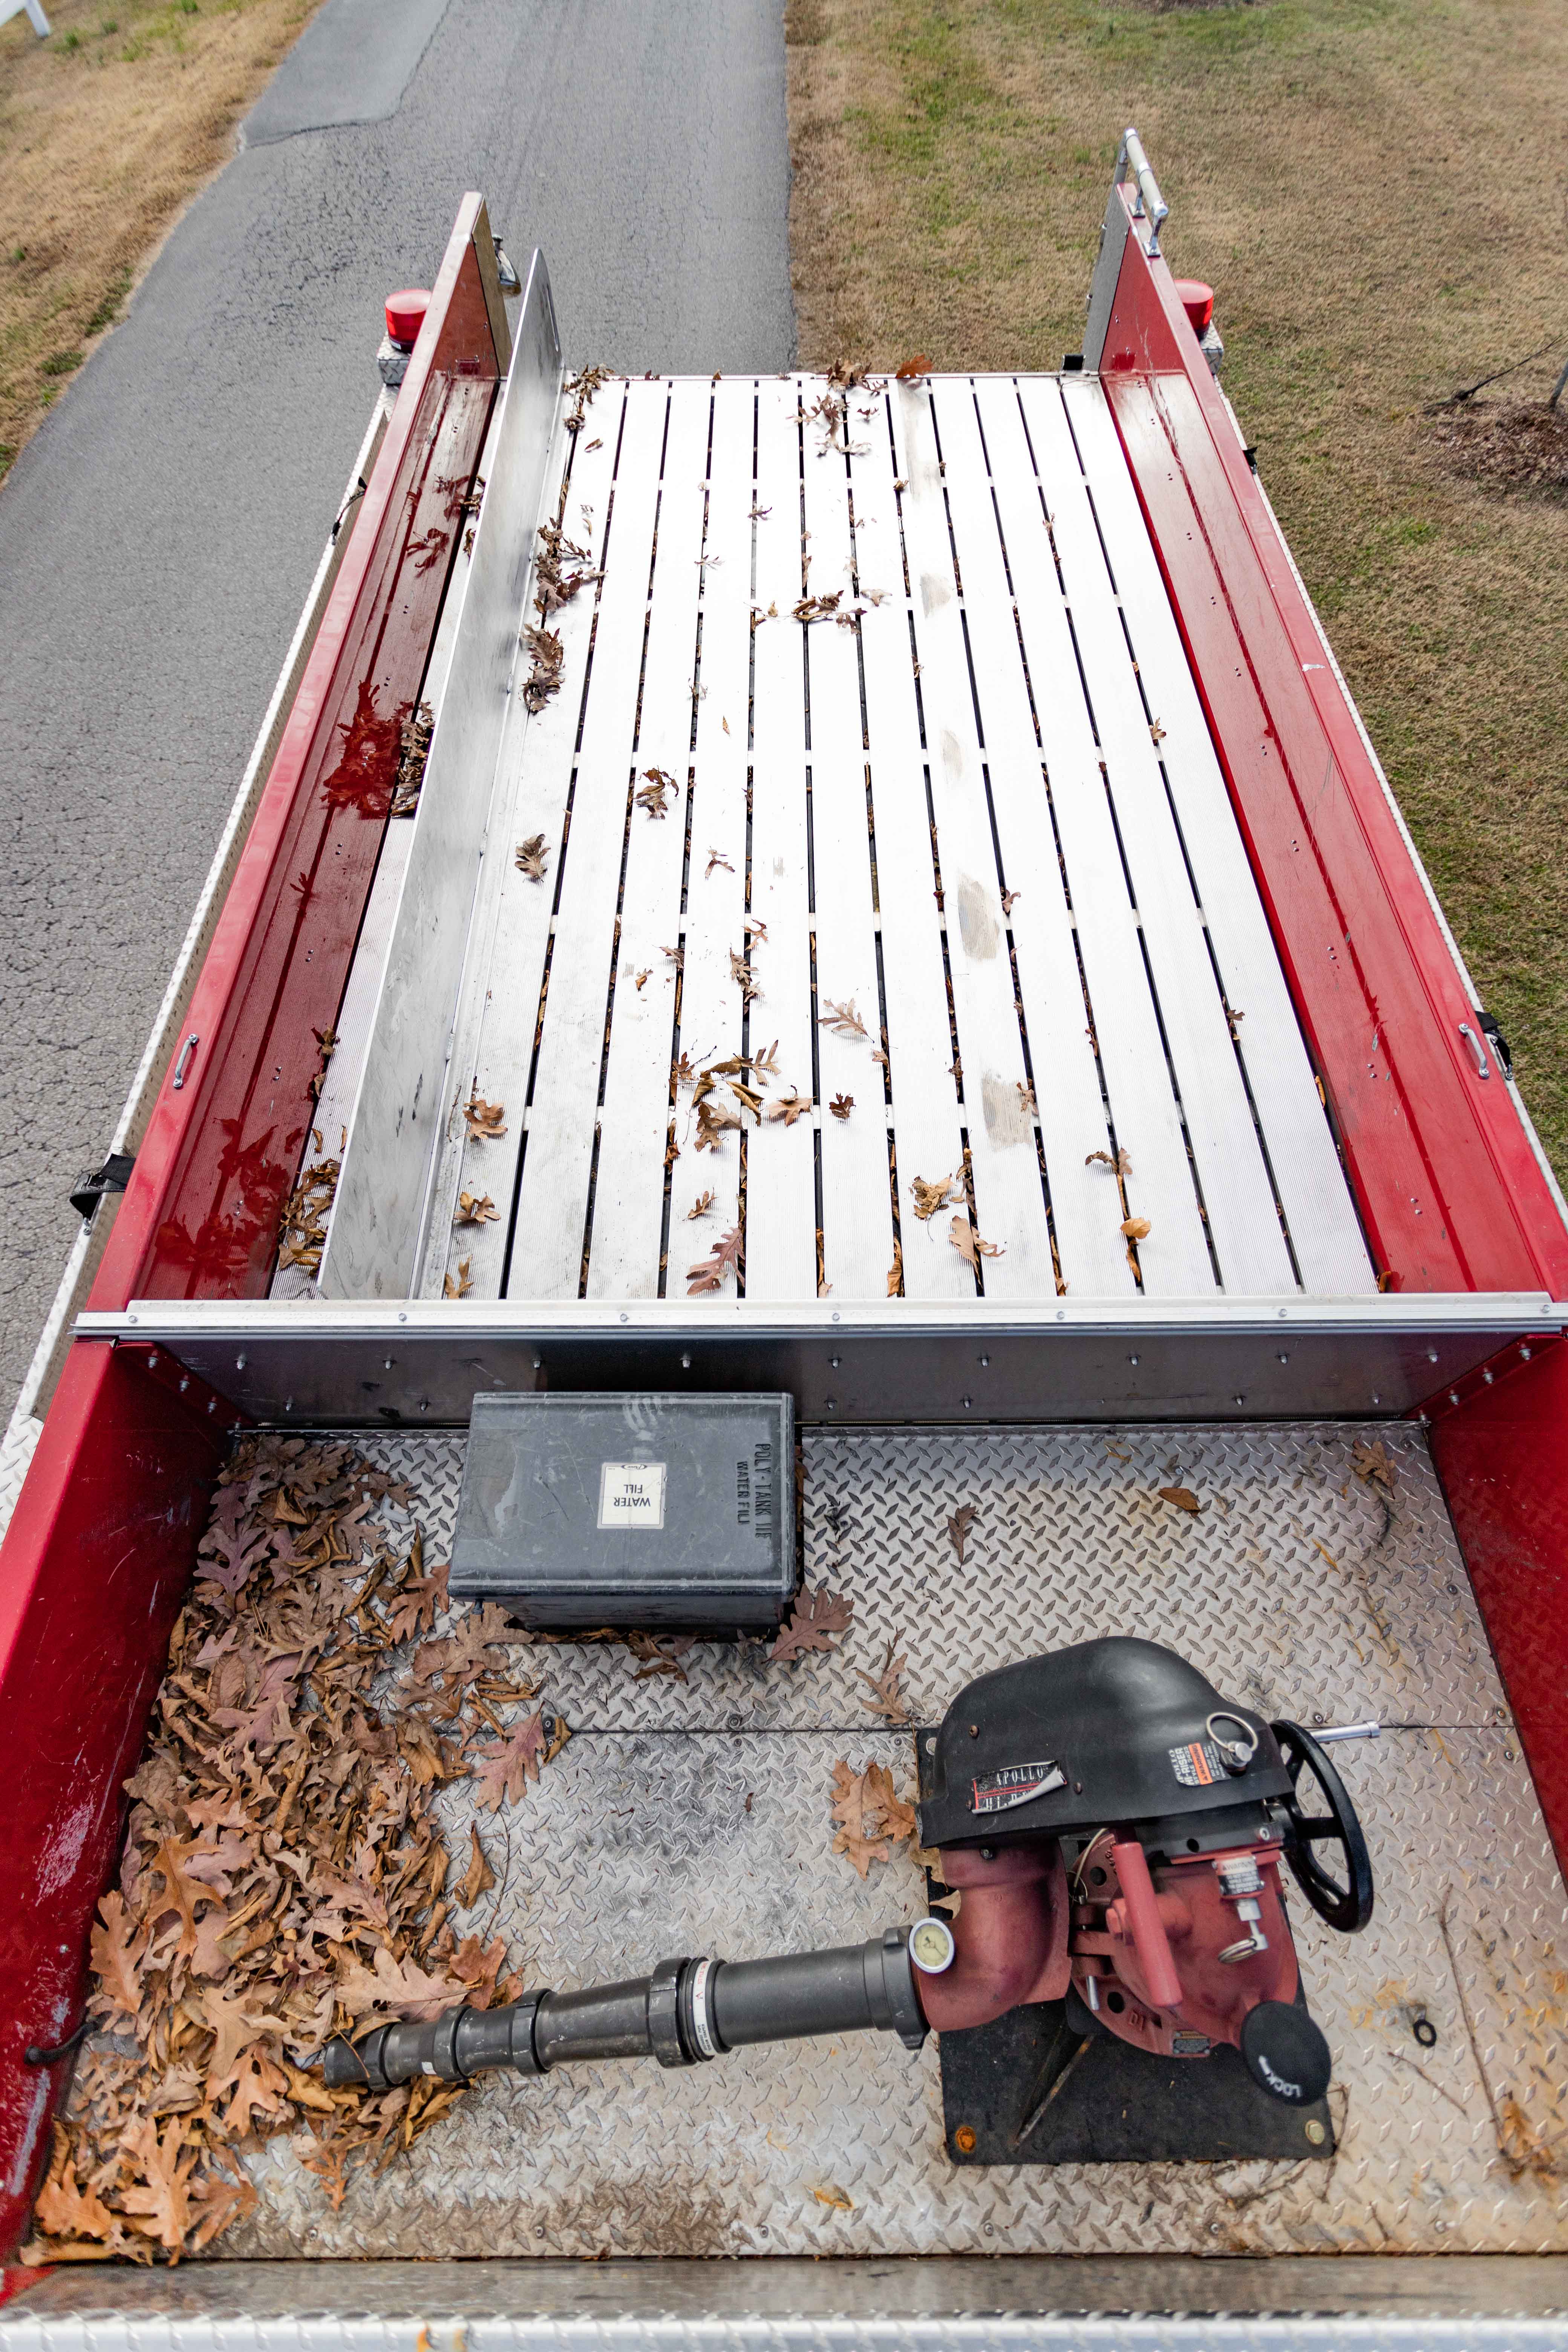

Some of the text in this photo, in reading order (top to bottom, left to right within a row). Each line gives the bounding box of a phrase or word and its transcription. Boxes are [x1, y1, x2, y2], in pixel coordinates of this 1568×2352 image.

[624, 1484, 643, 1493] FILL
[737, 1461, 750, 1499] WATER
[614, 1497, 651, 1507] WATER
[1192, 1745, 1206, 1776] WARNING
[1267, 2071, 1301, 2098] LOCK
